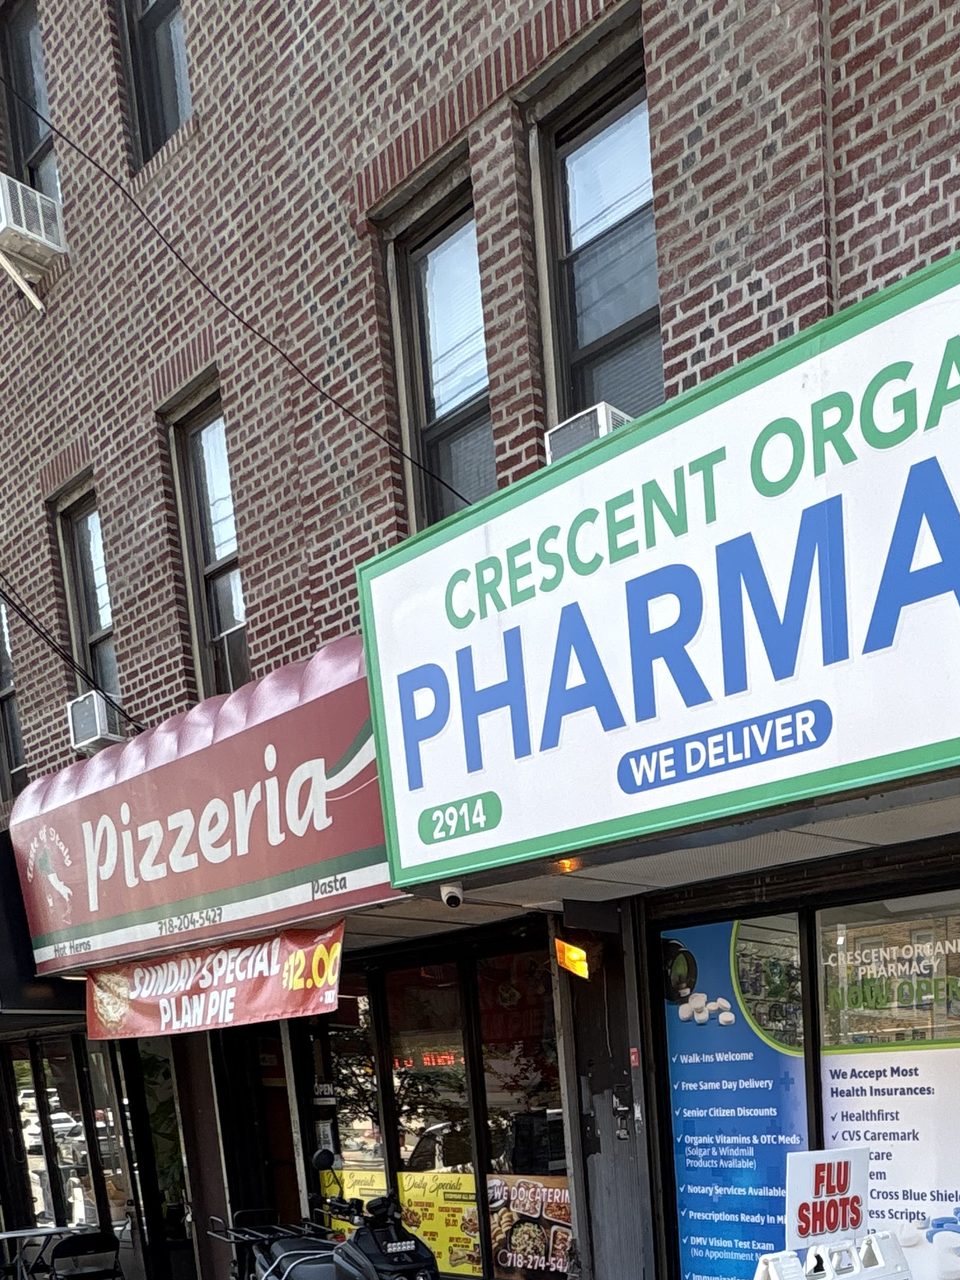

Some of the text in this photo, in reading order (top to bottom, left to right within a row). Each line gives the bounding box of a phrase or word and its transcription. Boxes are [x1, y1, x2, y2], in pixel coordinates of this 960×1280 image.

[445, 449, 728, 629] CRESCENT
[630, 710, 816, 786] WE DELIVER
[432, 800, 486, 839] 2914
[82, 744, 332, 911] Pizzeria
[311, 874, 347, 901] Pasta
[158, 907, 223, 936] 718-204-5427
[54, 939, 91, 958] Hot Heros
[828, 945, 899, 967] CRESCENT
[129, 937, 281, 999] SUNDAY SPECIAL
[282, 941, 342, 991] $12.00
[858, 958, 941, 979] PHARMACY
[829, 978, 891, 1010] NOW
[160, 986, 237, 1031] PLAN PIE
[680, 1052, 754, 1063] Walk-Ins Welcome
[829, 1066, 919, 1080] We Accept Most
[681, 1078, 774, 1091] Free Same Day Delivery
[830, 1085, 935, 1098] Health Insurances:
[683, 1107, 777, 1118] Senior Citizen Discounts
[840, 1109, 900, 1122] Healthfirst
[684, 1134, 801, 1146] Organic Vitamins & OTC Meds
[841, 1129, 920, 1142] CVS Caremark
[685, 1146, 754, 1156] (Solgar & Windmill
[686, 1158, 756, 1170] Products Available)
[814, 1160, 849, 1196] FLU
[403, 1174, 463, 1198] Daily Specials
[494, 1187, 508, 1200] WE
[510, 1187, 526, 1200] DO
[687, 1185, 786, 1197] Notary Services Available
[870, 1189, 900, 1200] Cross
[902, 1189, 928, 1201] Blue
[688, 1210, 776, 1225] Prescriptions Ready In
[797, 1195, 862, 1237] SHOTS
[887, 1209, 927, 1222] Scripts
[690, 1236, 775, 1250] DMV Vision Test Exam
[690, 1248, 704, 1258] (No
[704, 1249, 754, 1262] Appointment
